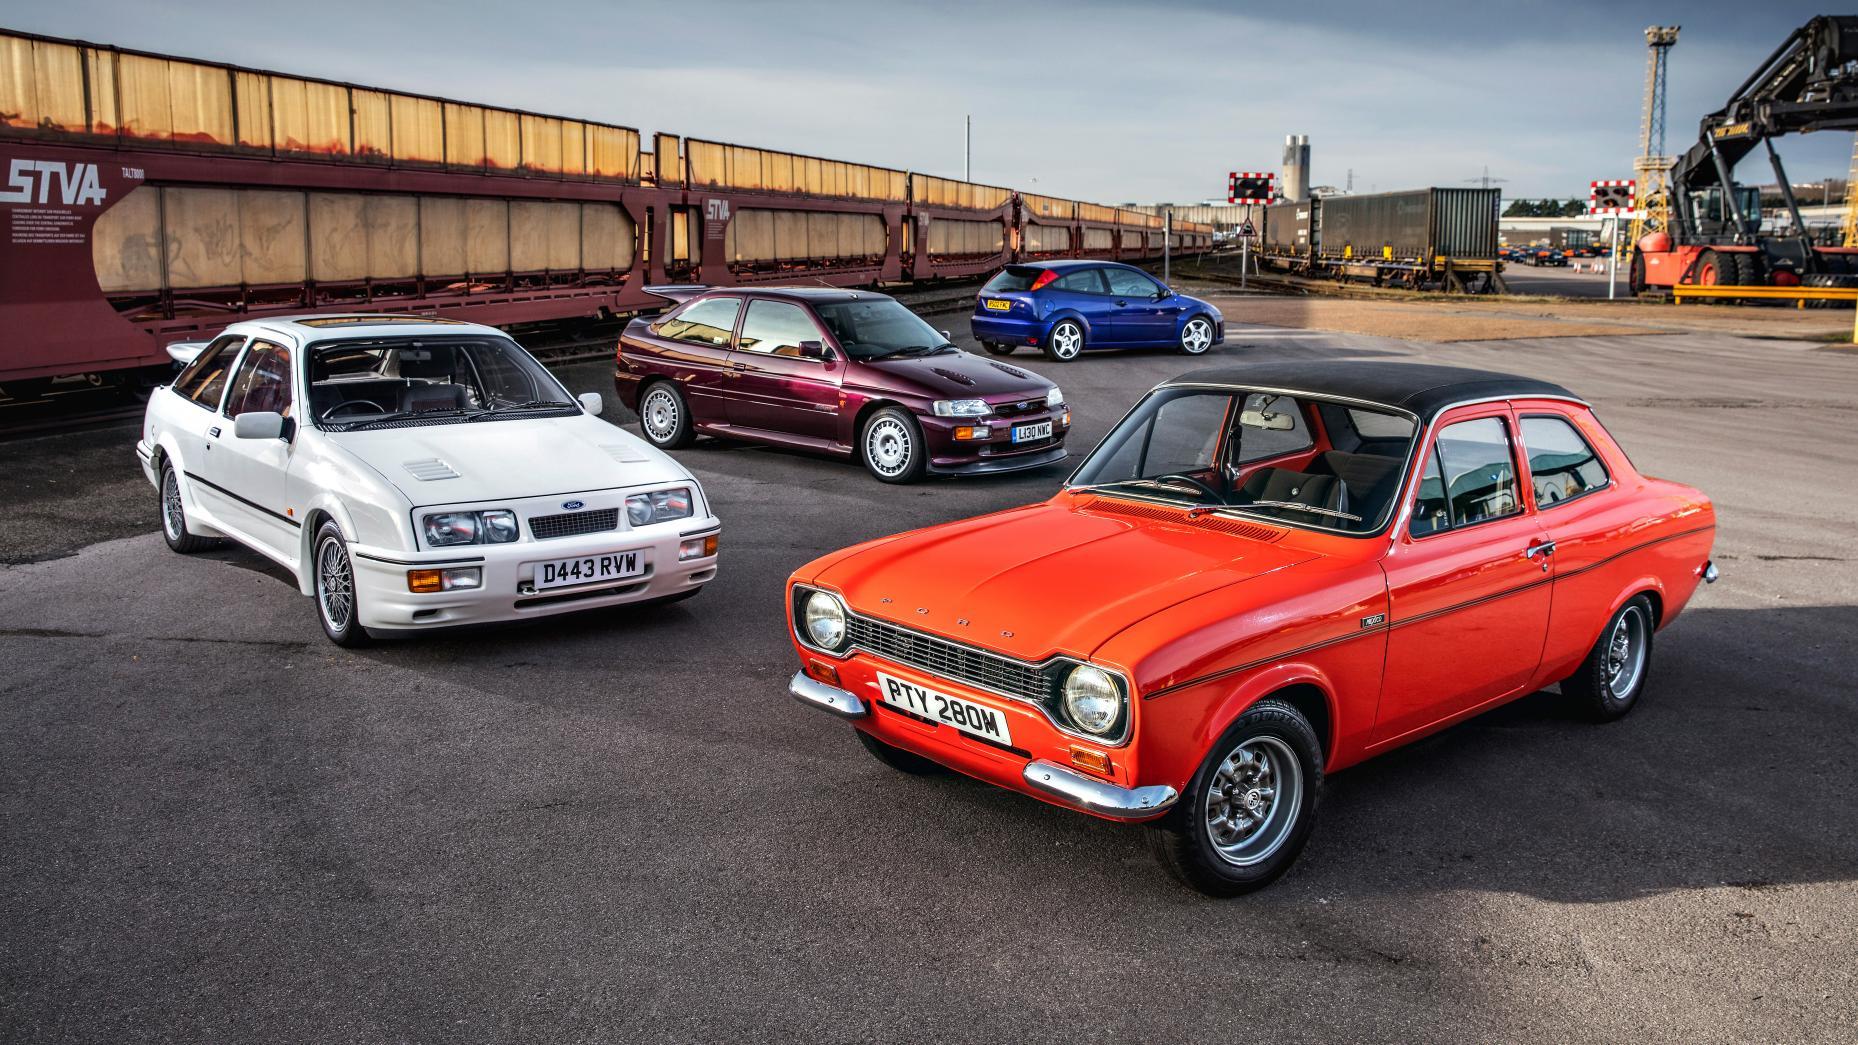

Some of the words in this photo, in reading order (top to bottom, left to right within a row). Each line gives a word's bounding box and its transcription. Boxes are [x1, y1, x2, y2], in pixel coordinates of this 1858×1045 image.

[0, 159, 107, 206] STVA
[706, 199, 730, 220] STVA
[1019, 426, 1036, 439] L130
[543, 559, 595, 583] D443
[600, 553, 637, 576] RVW
[886, 678, 929, 713] PTY
[935, 695, 1000, 736] 280M
